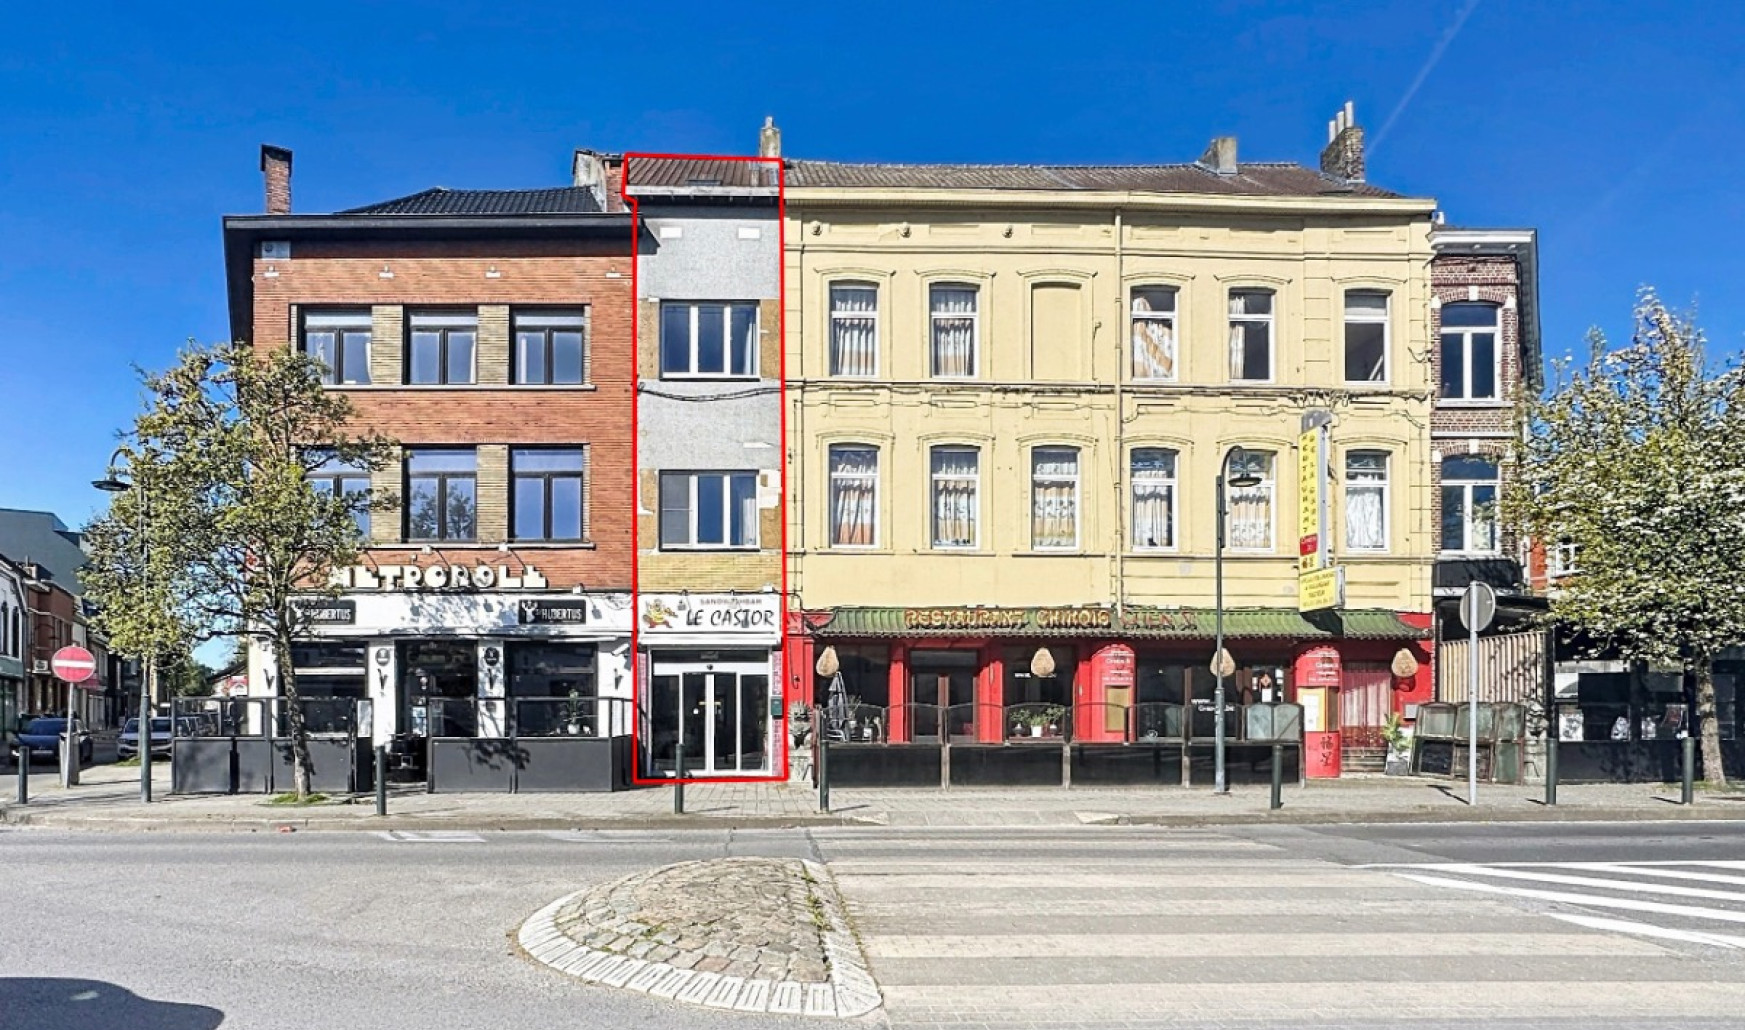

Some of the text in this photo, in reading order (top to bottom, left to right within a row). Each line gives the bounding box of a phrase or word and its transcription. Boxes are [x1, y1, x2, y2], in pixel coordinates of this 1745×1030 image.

[310, 608, 352, 620] HBERTUS
[542, 608, 582, 620] HUBERTUS
[686, 609, 775, 626] LE CASTOR
[904, 609, 1026, 626] RESTAURANT
[1036, 609, 1110, 627] CHINOIS
